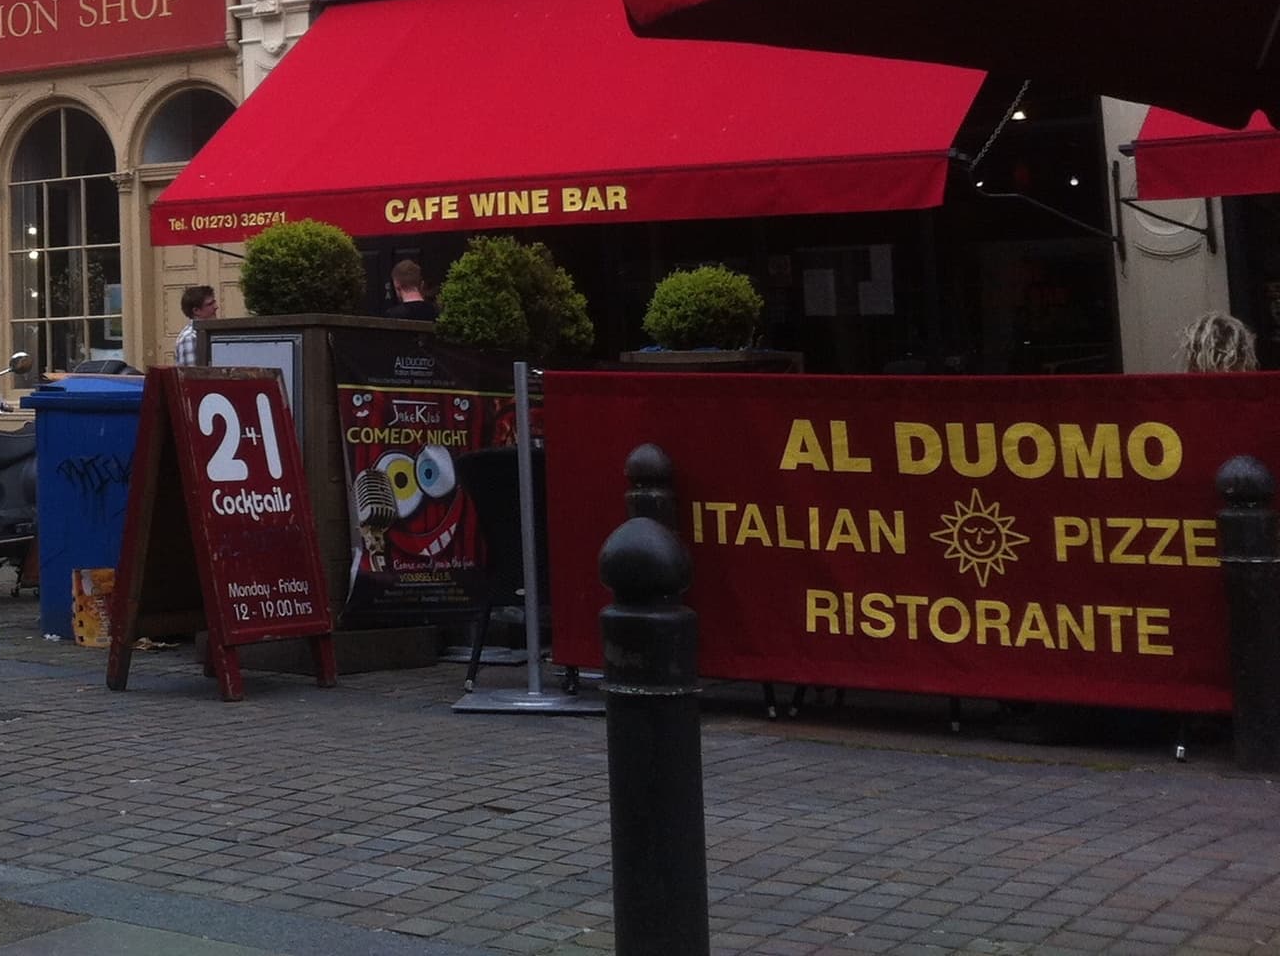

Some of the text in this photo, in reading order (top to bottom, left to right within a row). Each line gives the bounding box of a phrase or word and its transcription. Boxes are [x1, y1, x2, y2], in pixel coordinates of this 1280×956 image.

[168, 218, 188, 231] Tel.
[191, 213, 238, 231] (01273)
[384, 185, 628, 224] CAFE WINE BAR
[346, 426, 468, 446] COMEDY NIGHT
[780, 418, 1183, 480] AL DUOMO
[212, 486, 291, 521] Cocktails
[691, 501, 907, 555] ITALIAN
[228, 581, 271, 599] Monday
[233, 603, 250, 621] 12
[260, 599, 293, 618] 19.00
[294, 599, 313, 615] hrs
[805, 589, 1174, 656] RISTORANTE
